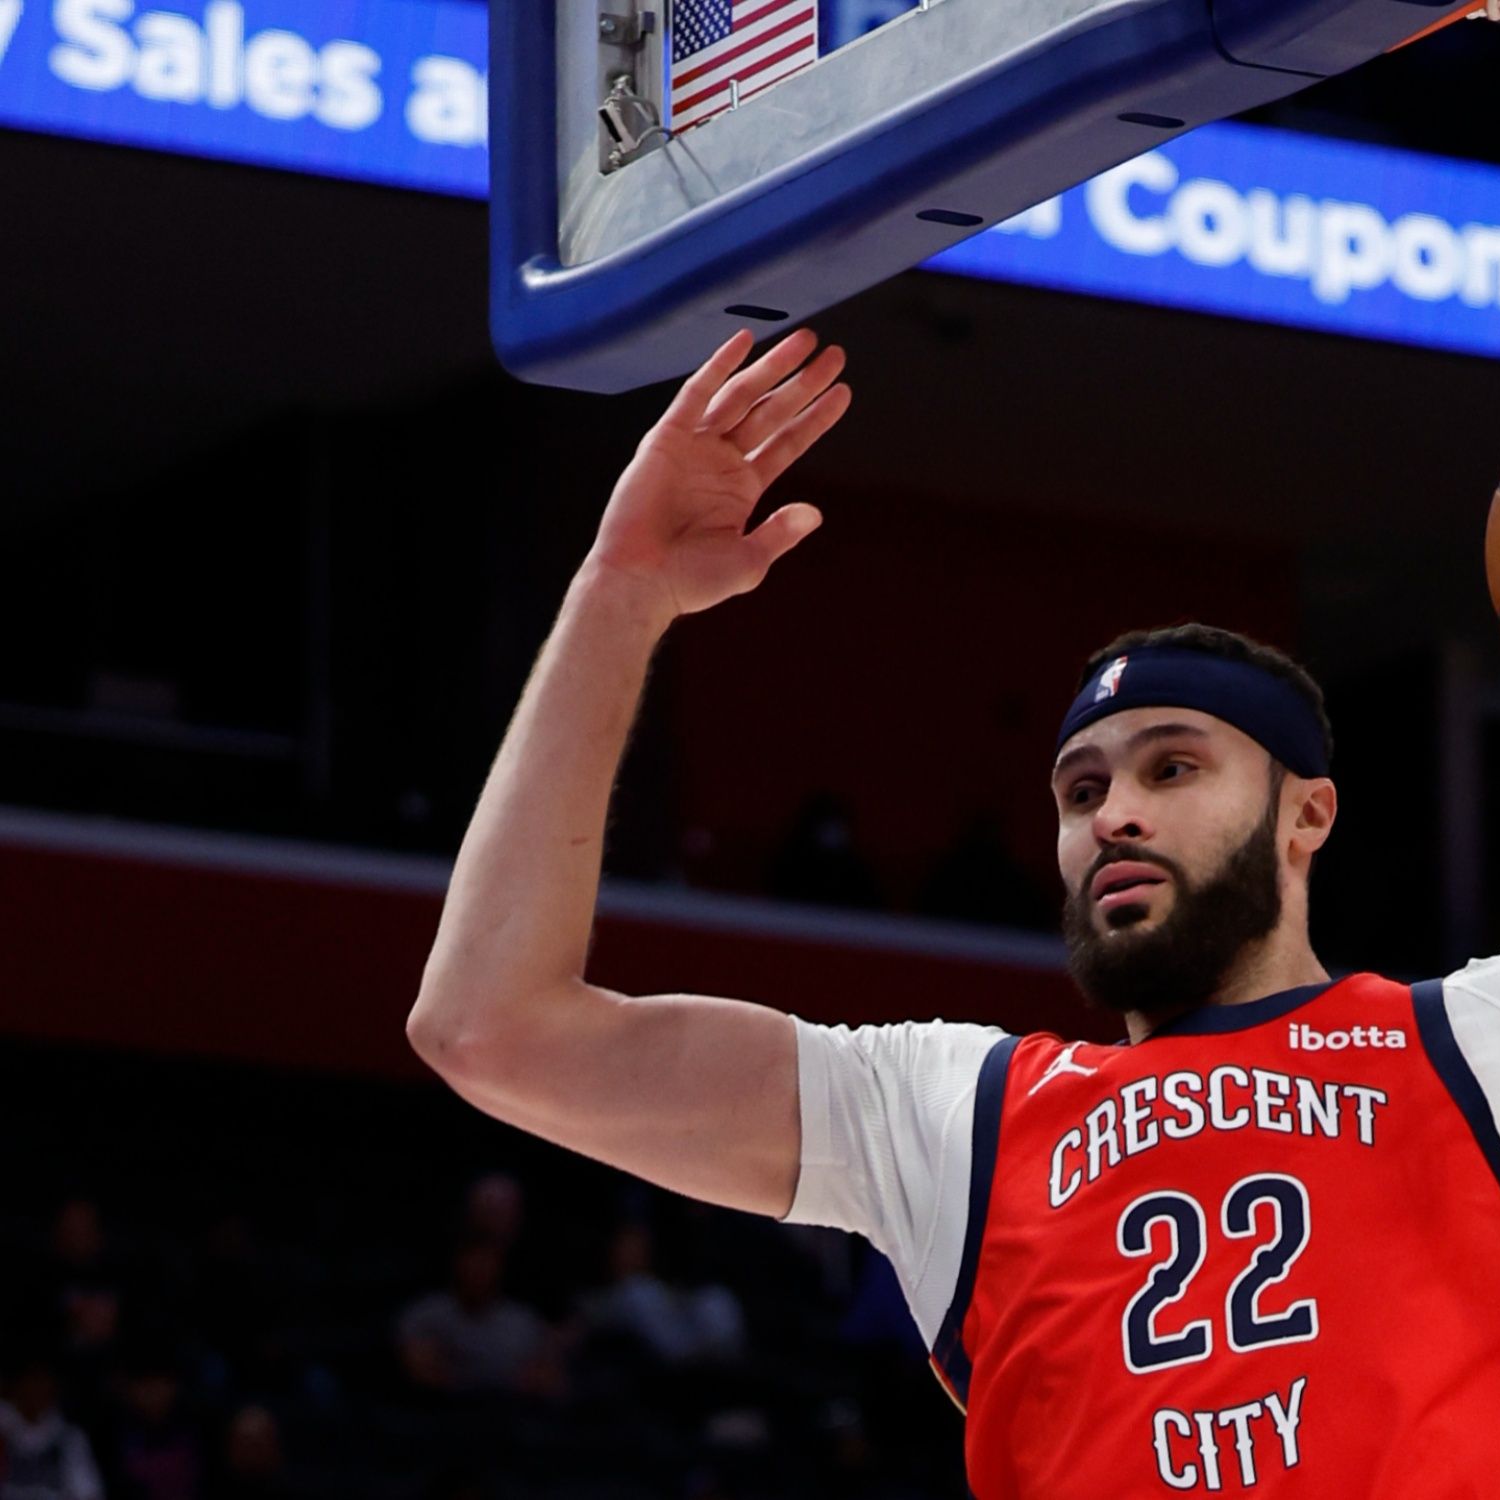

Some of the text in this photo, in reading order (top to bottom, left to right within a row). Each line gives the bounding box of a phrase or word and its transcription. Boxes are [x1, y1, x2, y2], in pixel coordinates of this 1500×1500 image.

[50, 0, 382, 131] Sales
[405, 55, 489, 147] a
[1289, 1022, 1406, 1050] ibotta
[1048, 1064, 1388, 1208] CRESCENT
[1116, 1171, 1320, 1375] 22
[1152, 1376, 1307, 1491] CITY
